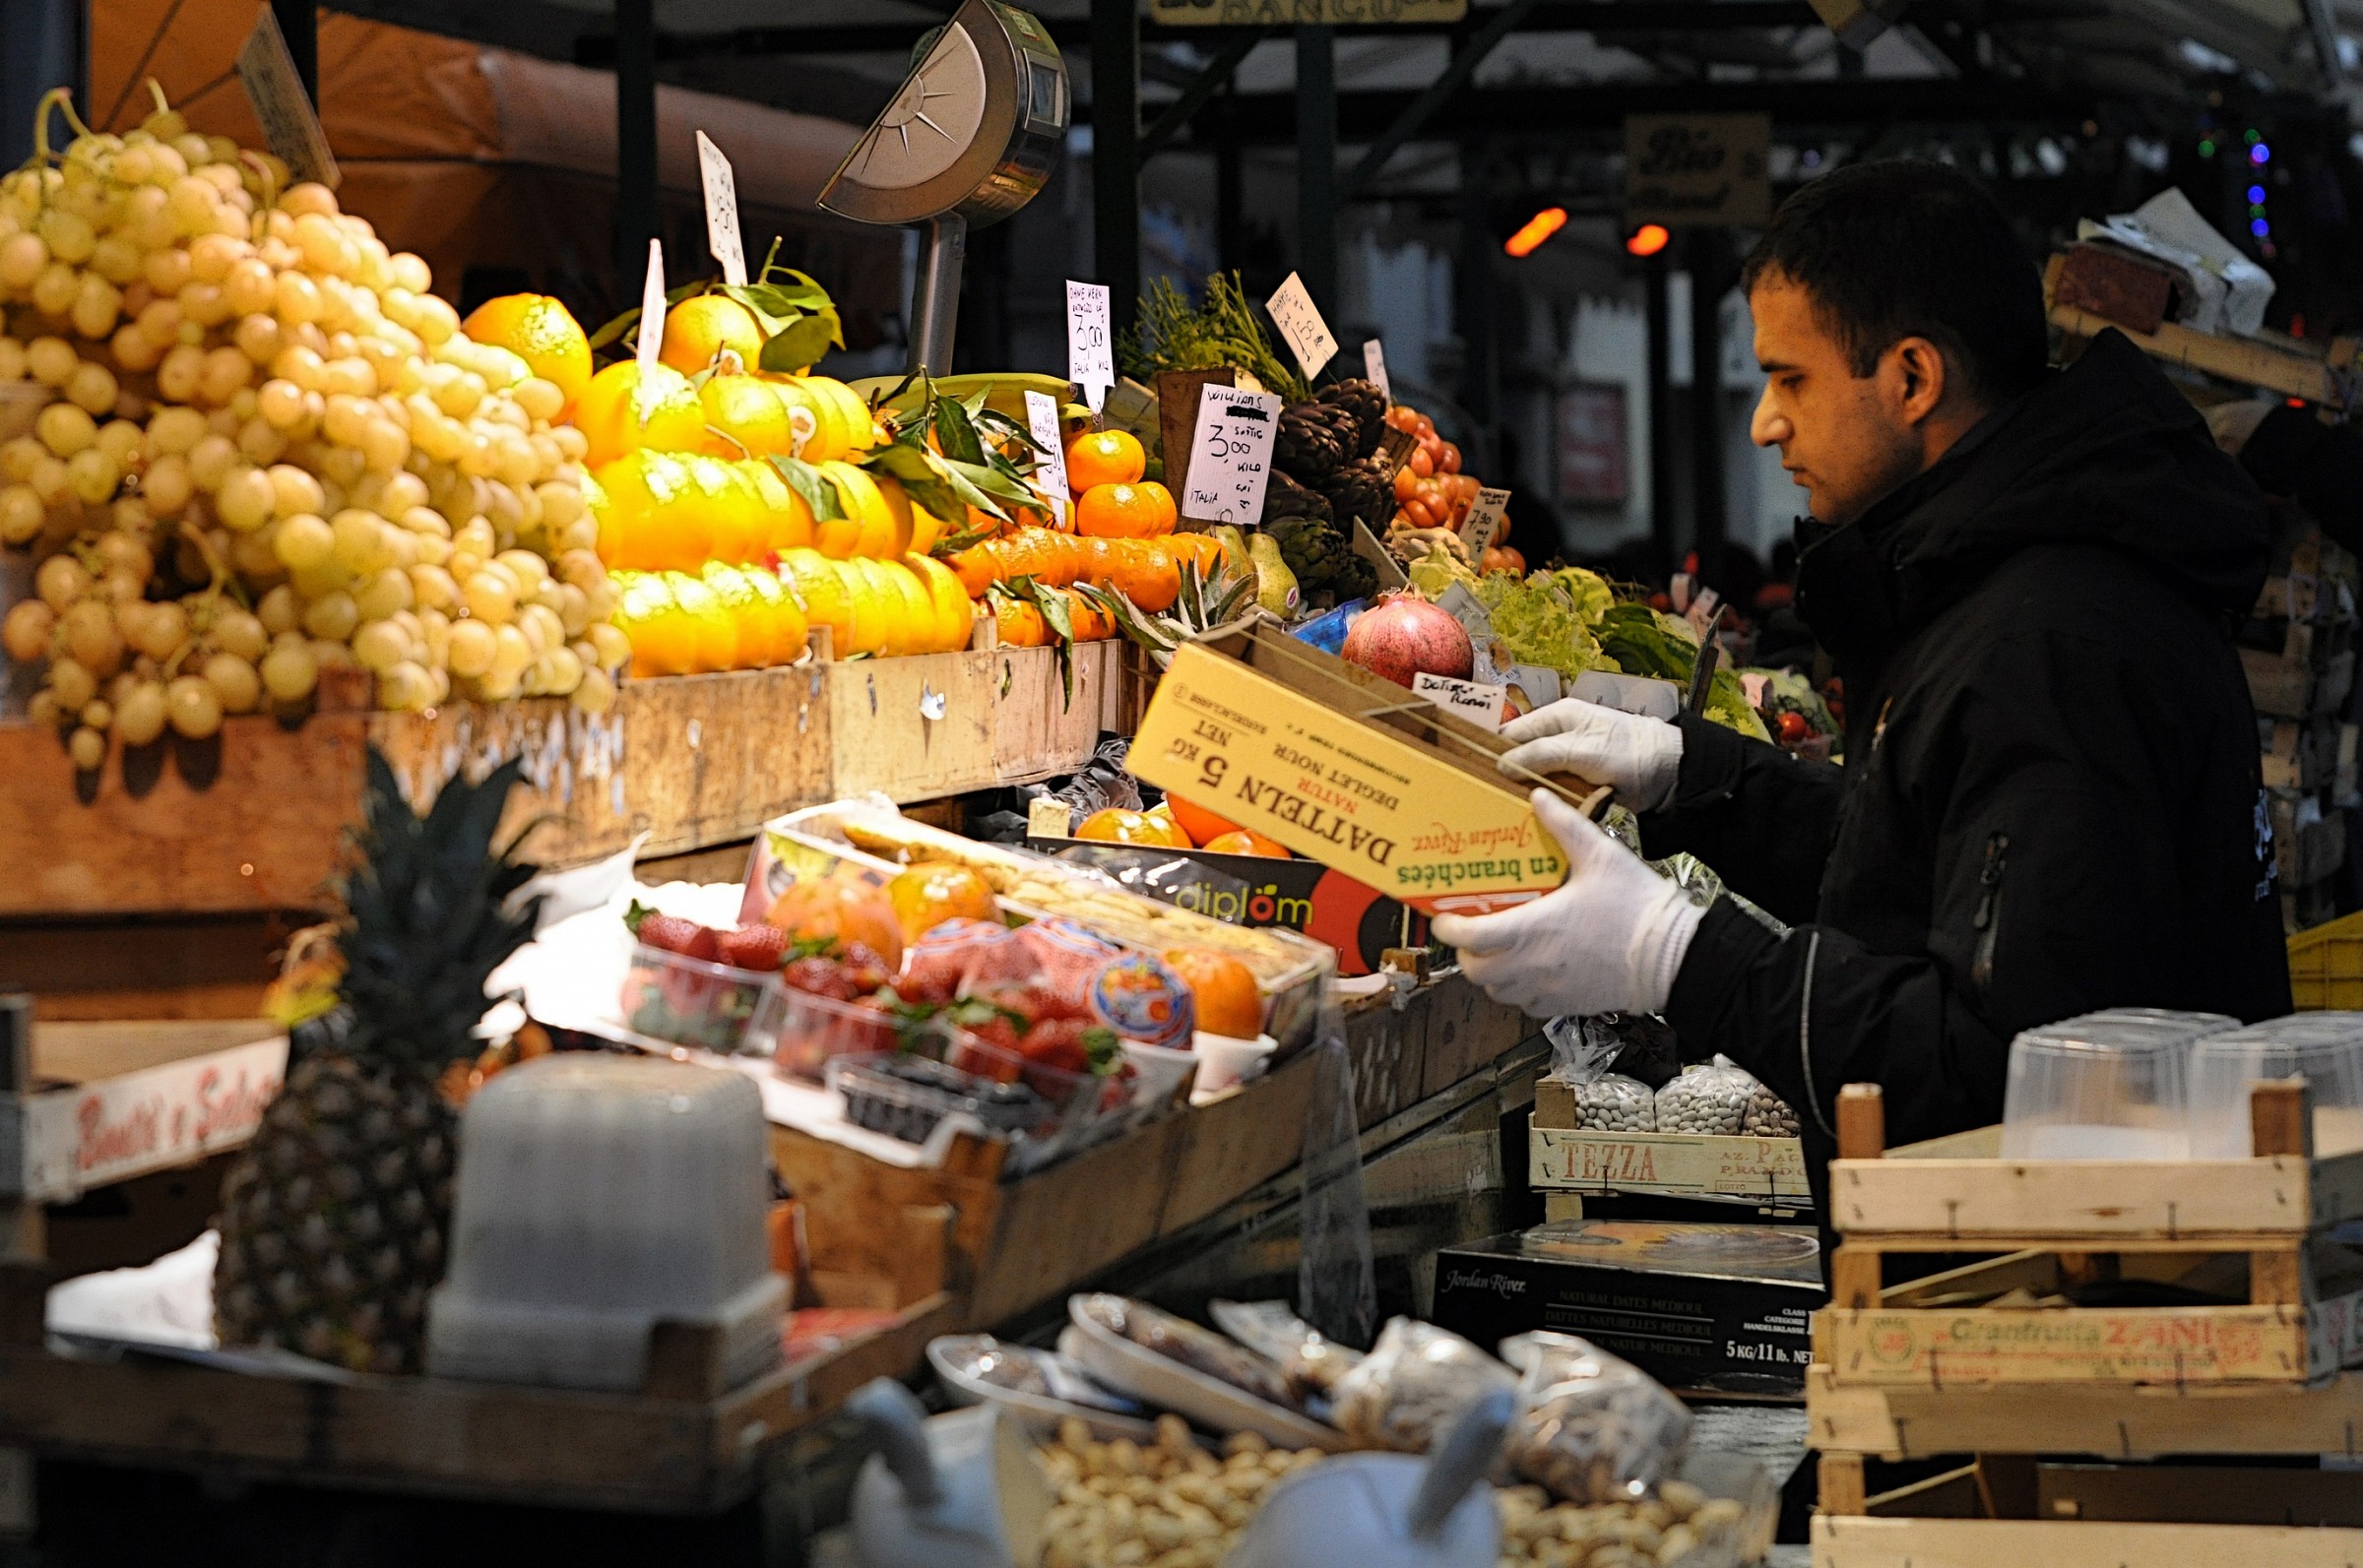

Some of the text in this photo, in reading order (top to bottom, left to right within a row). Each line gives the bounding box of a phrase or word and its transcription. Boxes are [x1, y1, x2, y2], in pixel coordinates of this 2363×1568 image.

[1192, 720, 1232, 747] NET
[1273, 742, 1400, 811] DEGLET NOUR
[1173, 738, 1396, 866] DATTELN 5 KG
[1297, 777, 1359, 815] NATUR
[1396, 858, 1522, 889] branchées
[1562, 1142, 1658, 1181] TEZZA
[1441, 1268, 1489, 1297] Jordan
[1559, 1289, 1610, 1306] NATURAL
[1612, 1293, 1649, 1311] DATES
[1781, 1307, 1807, 1318] CLASS
[1743, 1322, 1806, 1336] HANDELSKLASSE
[1763, 1315, 1806, 1326] CATEGORIE
[2104, 1318, 2212, 1346] ZANI
